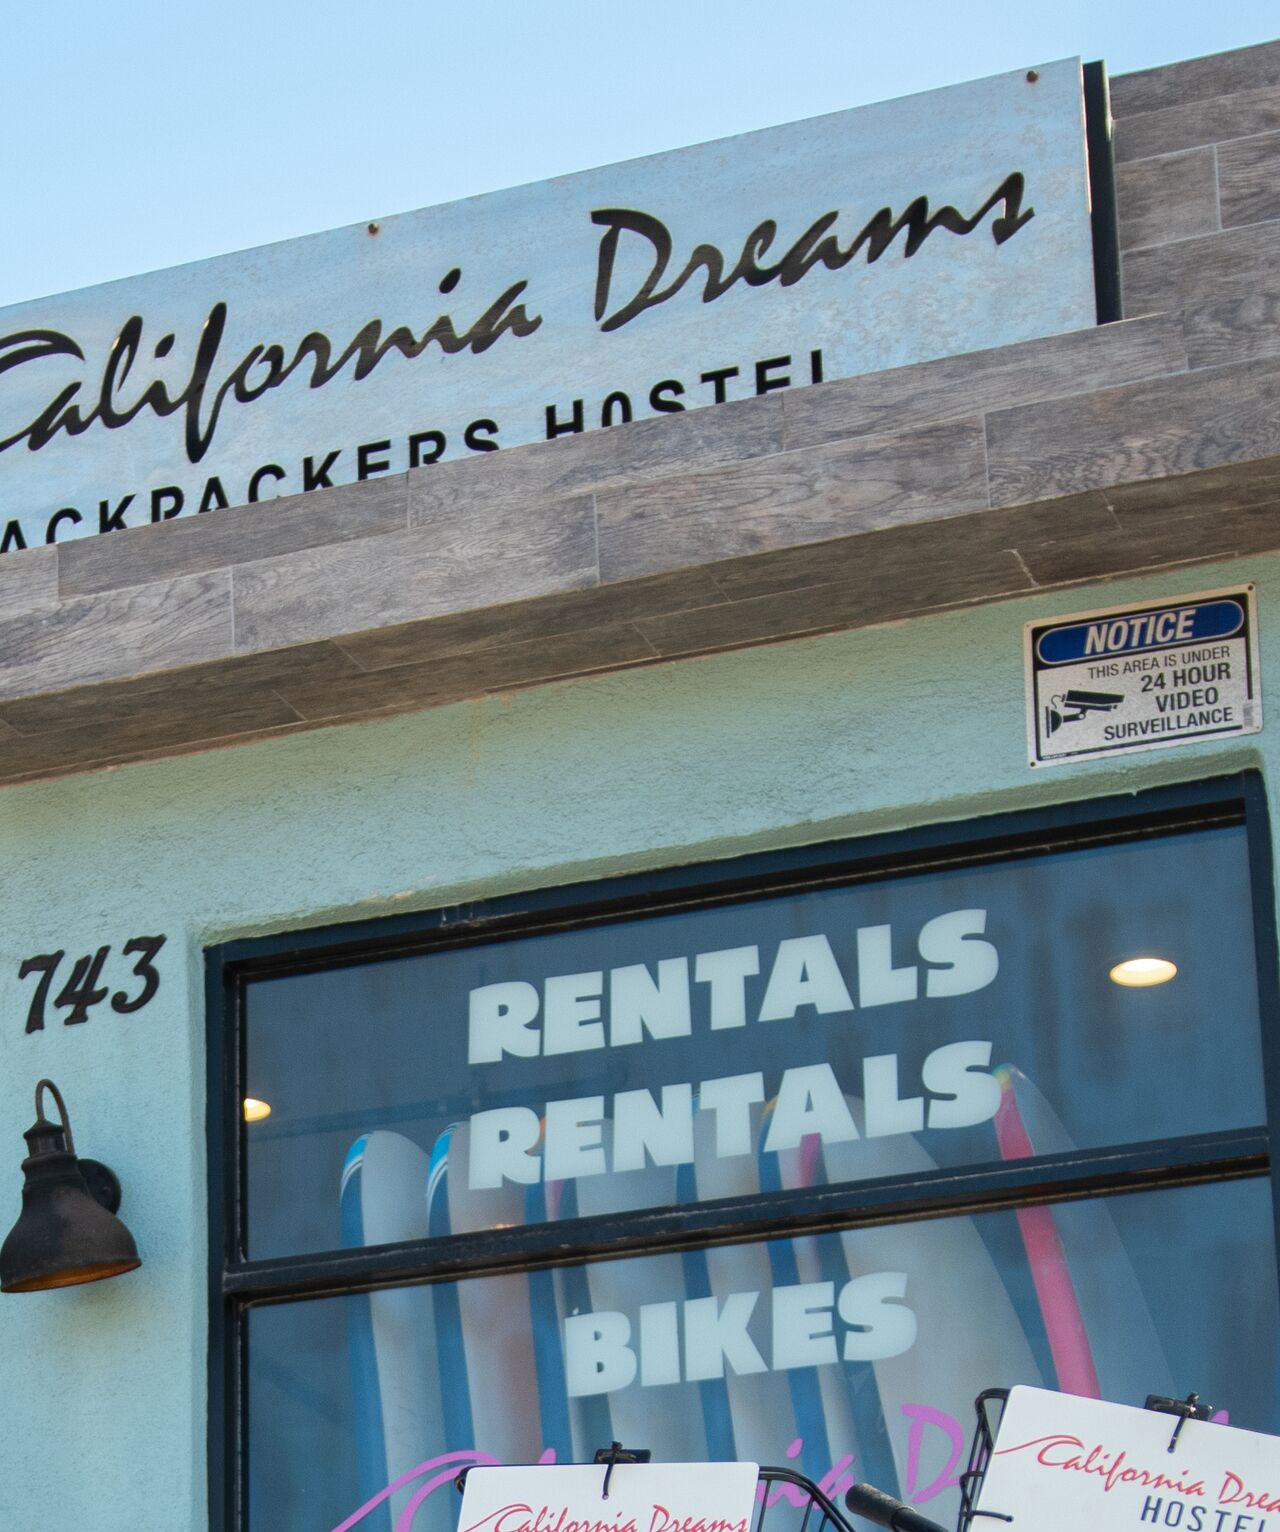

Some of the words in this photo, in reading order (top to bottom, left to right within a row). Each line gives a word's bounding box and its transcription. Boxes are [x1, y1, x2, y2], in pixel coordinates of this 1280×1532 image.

[590, 171, 1036, 332] Dreams
[1084, 608, 1196, 656] NOTICE
[1088, 664, 1119, 680] THIS
[1123, 657, 1160, 676] AREA
[1164, 653, 1178, 668] IS
[1182, 646, 1231, 666] UNDER
[1141, 675, 1167, 693] 24
[1173, 662, 1232, 688] HOUR
[1155, 687, 1219, 713] VIDEO
[1104, 706, 1233, 741] SURVEILLANCE
[18, 933, 167, 1035] 743
[468, 909, 999, 1065] RENTALS
[468, 1040, 1002, 1190] RENTALS
[564, 1272, 918, 1398] BIKES
[994, 1435, 1206, 1497] California
